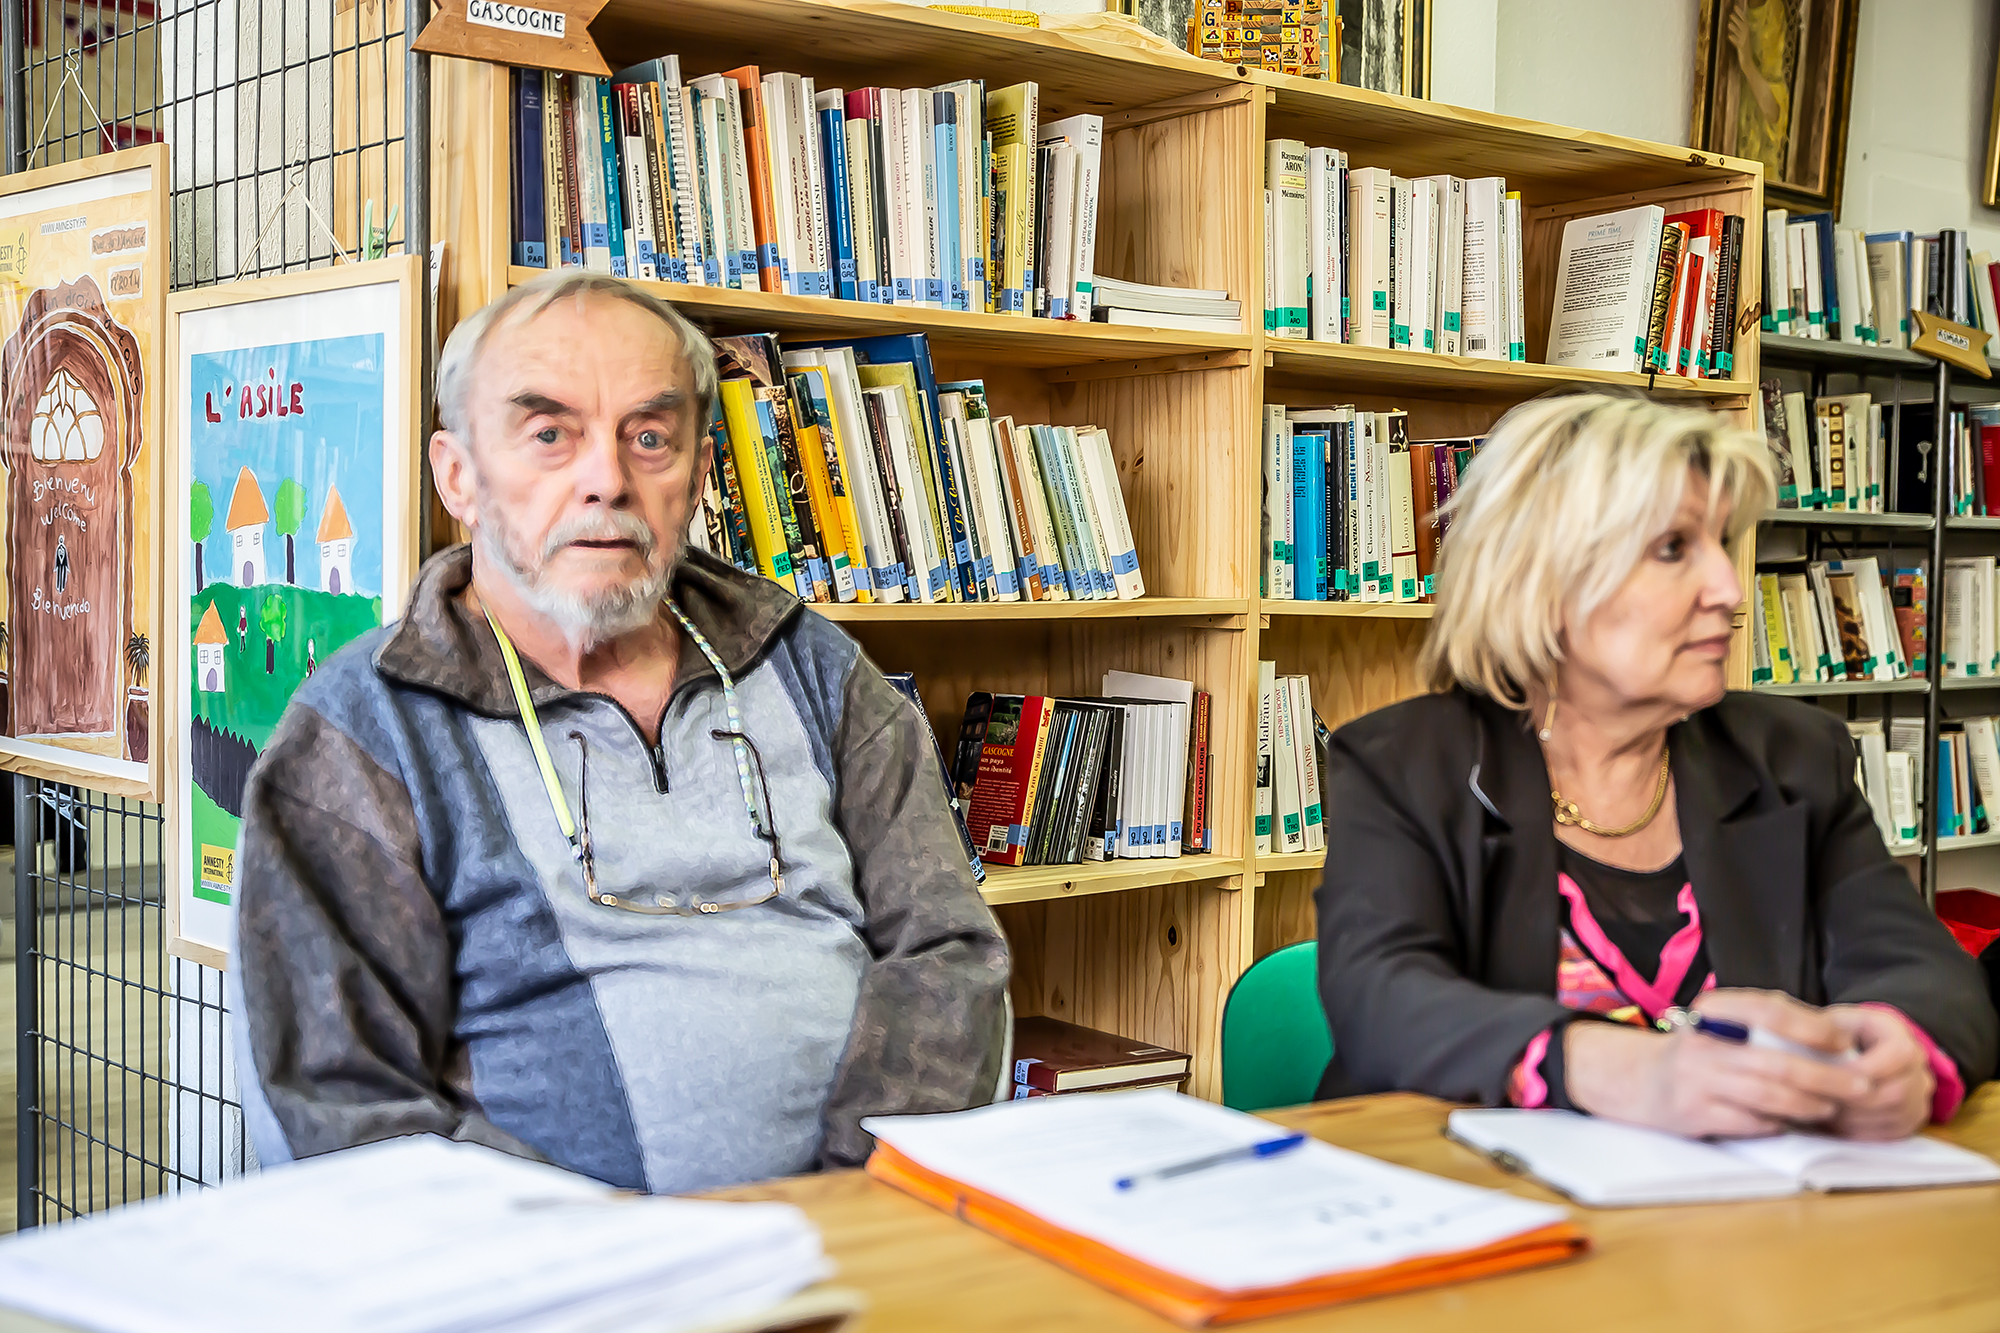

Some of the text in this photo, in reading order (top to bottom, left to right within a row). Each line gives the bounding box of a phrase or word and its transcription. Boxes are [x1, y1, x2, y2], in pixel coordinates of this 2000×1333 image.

[470, 0, 563, 32] GASCOGNE
[1205, 12, 1214, 26] G
[1285, 12, 1294, 23] K
[1227, 32, 1235, 40] N
[1245, 31, 1254, 40] O
[1303, 29, 1313, 42] R
[1304, 47, 1314, 64] X
[1029, 96, 1037, 154] Grands-Mères
[1282, 151, 1304, 161] Raymond
[1285, 161, 1301, 172] ARON
[1282, 190, 1304, 199] Mémoires
[41, 216, 87, 234] WWW.AMNESTY.FR
[805, 210, 813, 241] LANDE
[1588, 229, 1607, 237] PRIME
[527, 255, 544, 264] PAR
[778, 563, 791, 573] FED
[1260, 693, 1270, 752] Malraux
[982, 746, 1014, 757] GASCOGNE
[990, 766, 1012, 774] identité
[1305, 744, 1315, 794] VERLAINE
[204, 856, 224, 869] AMNESTY
